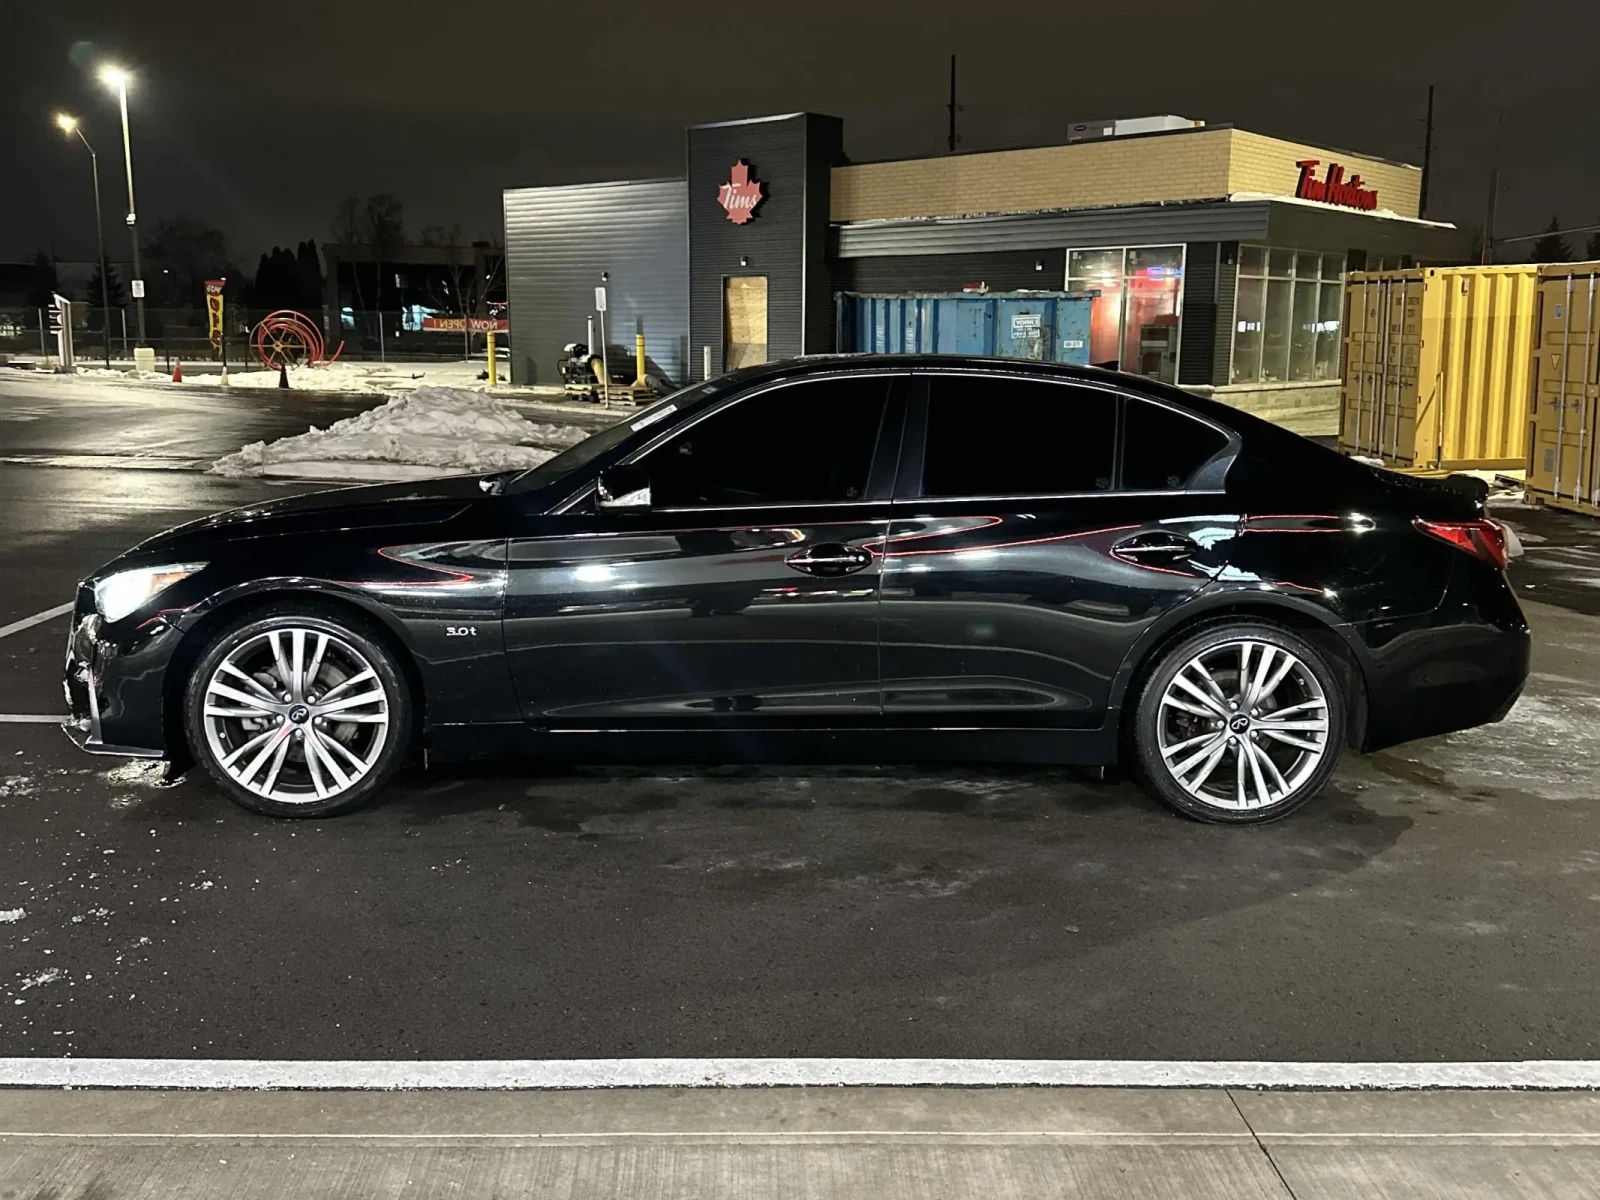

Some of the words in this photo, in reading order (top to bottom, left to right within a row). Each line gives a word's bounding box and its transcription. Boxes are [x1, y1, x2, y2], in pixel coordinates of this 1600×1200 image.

[722, 182, 758, 210] Tims
[1296, 160, 1326, 202] Tim
[1323, 163, 1378, 212] Hortons
